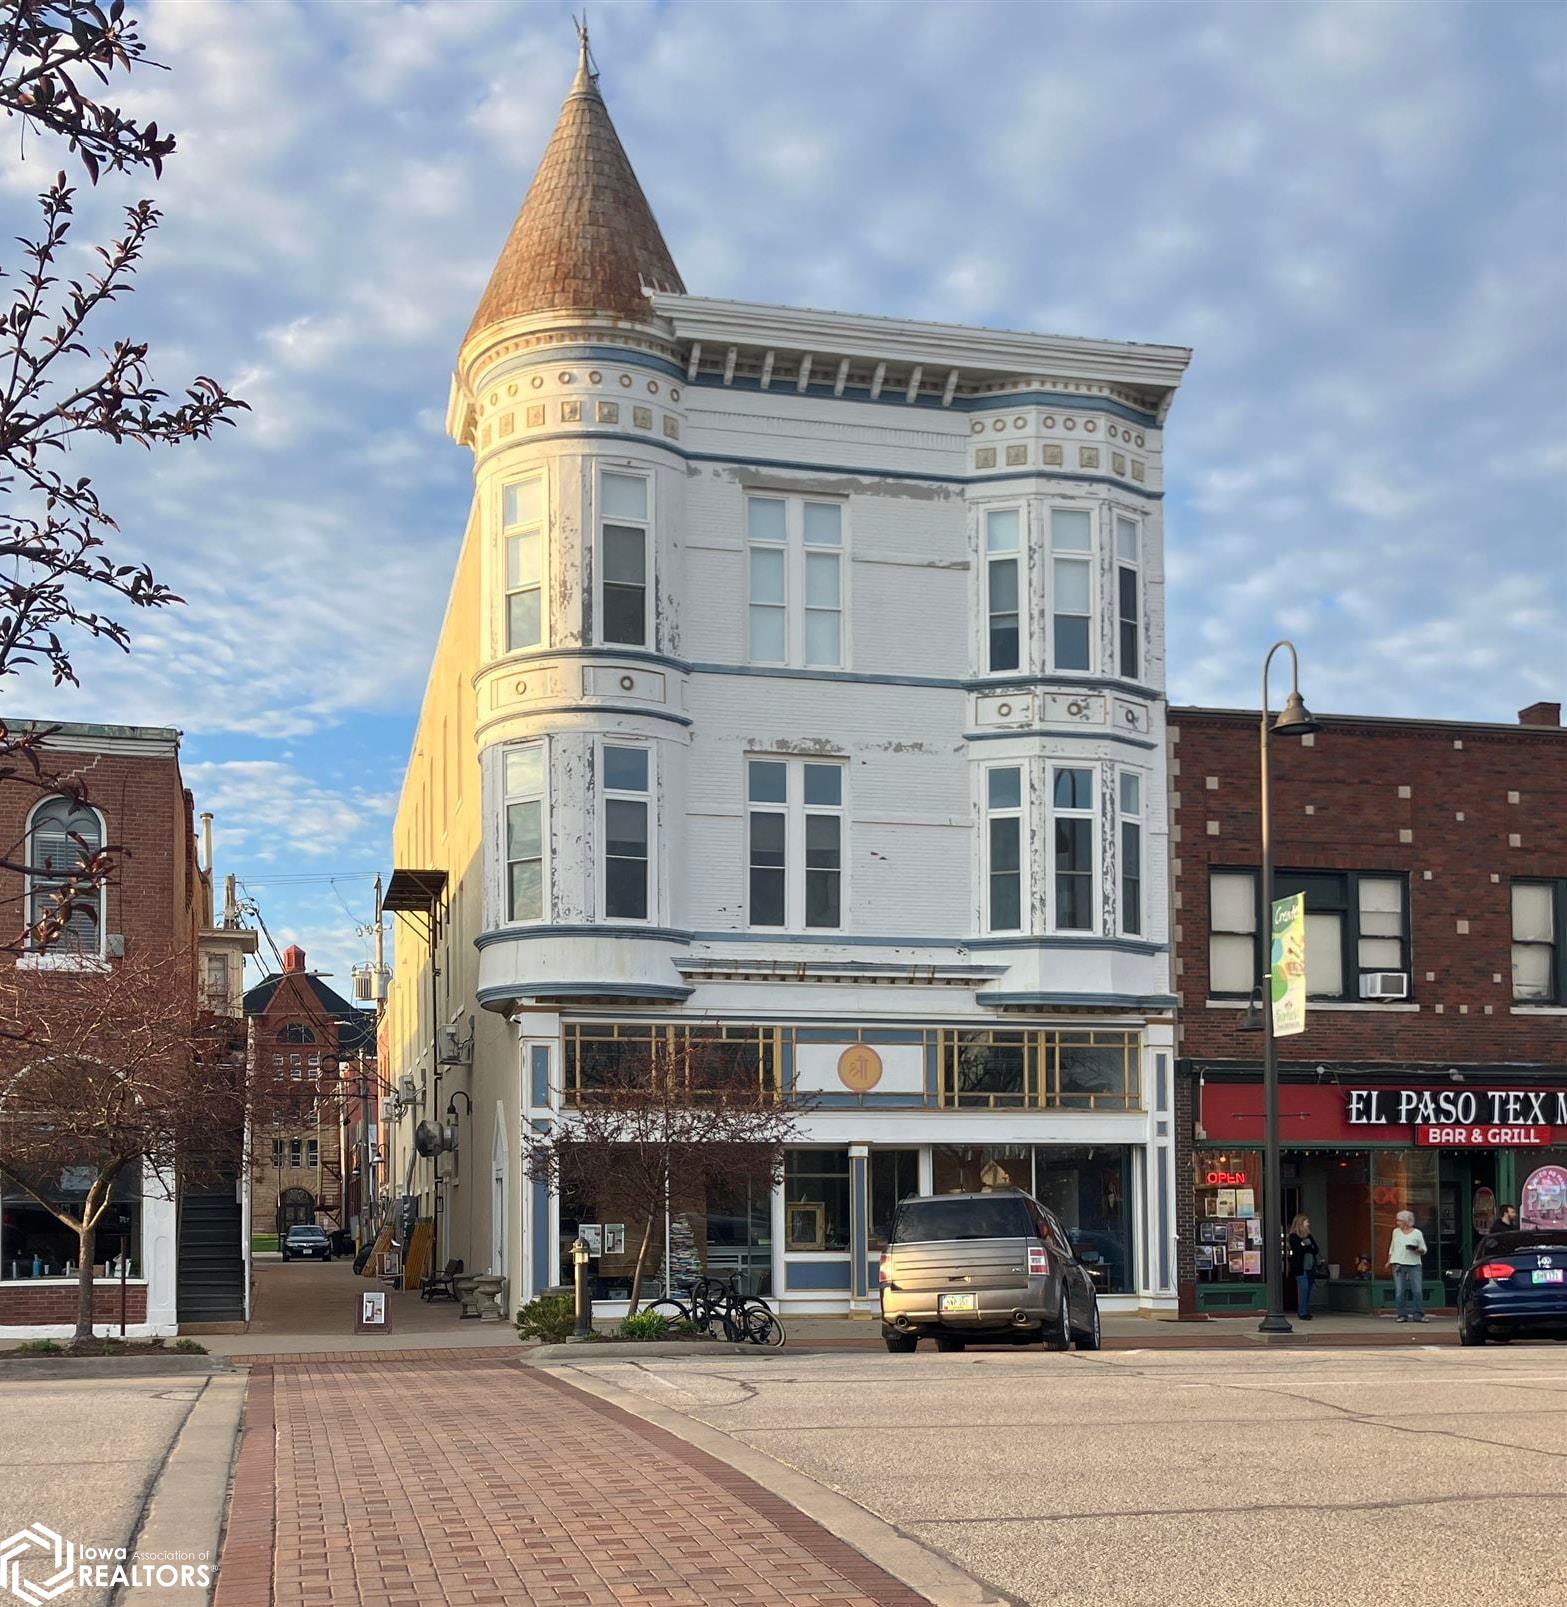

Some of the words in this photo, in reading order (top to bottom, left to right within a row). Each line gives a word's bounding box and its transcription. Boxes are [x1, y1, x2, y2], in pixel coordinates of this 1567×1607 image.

[1347, 1091, 1386, 1124] EL
[1397, 1091, 1476, 1125] PASO
[1487, 1091, 1547, 1125] TEX
[1428, 1129, 1466, 1143] BAR
[1471, 1129, 1483, 1143] &
[1487, 1129, 1540, 1143] GRILL
[1207, 1172, 1246, 1184] OPEN
